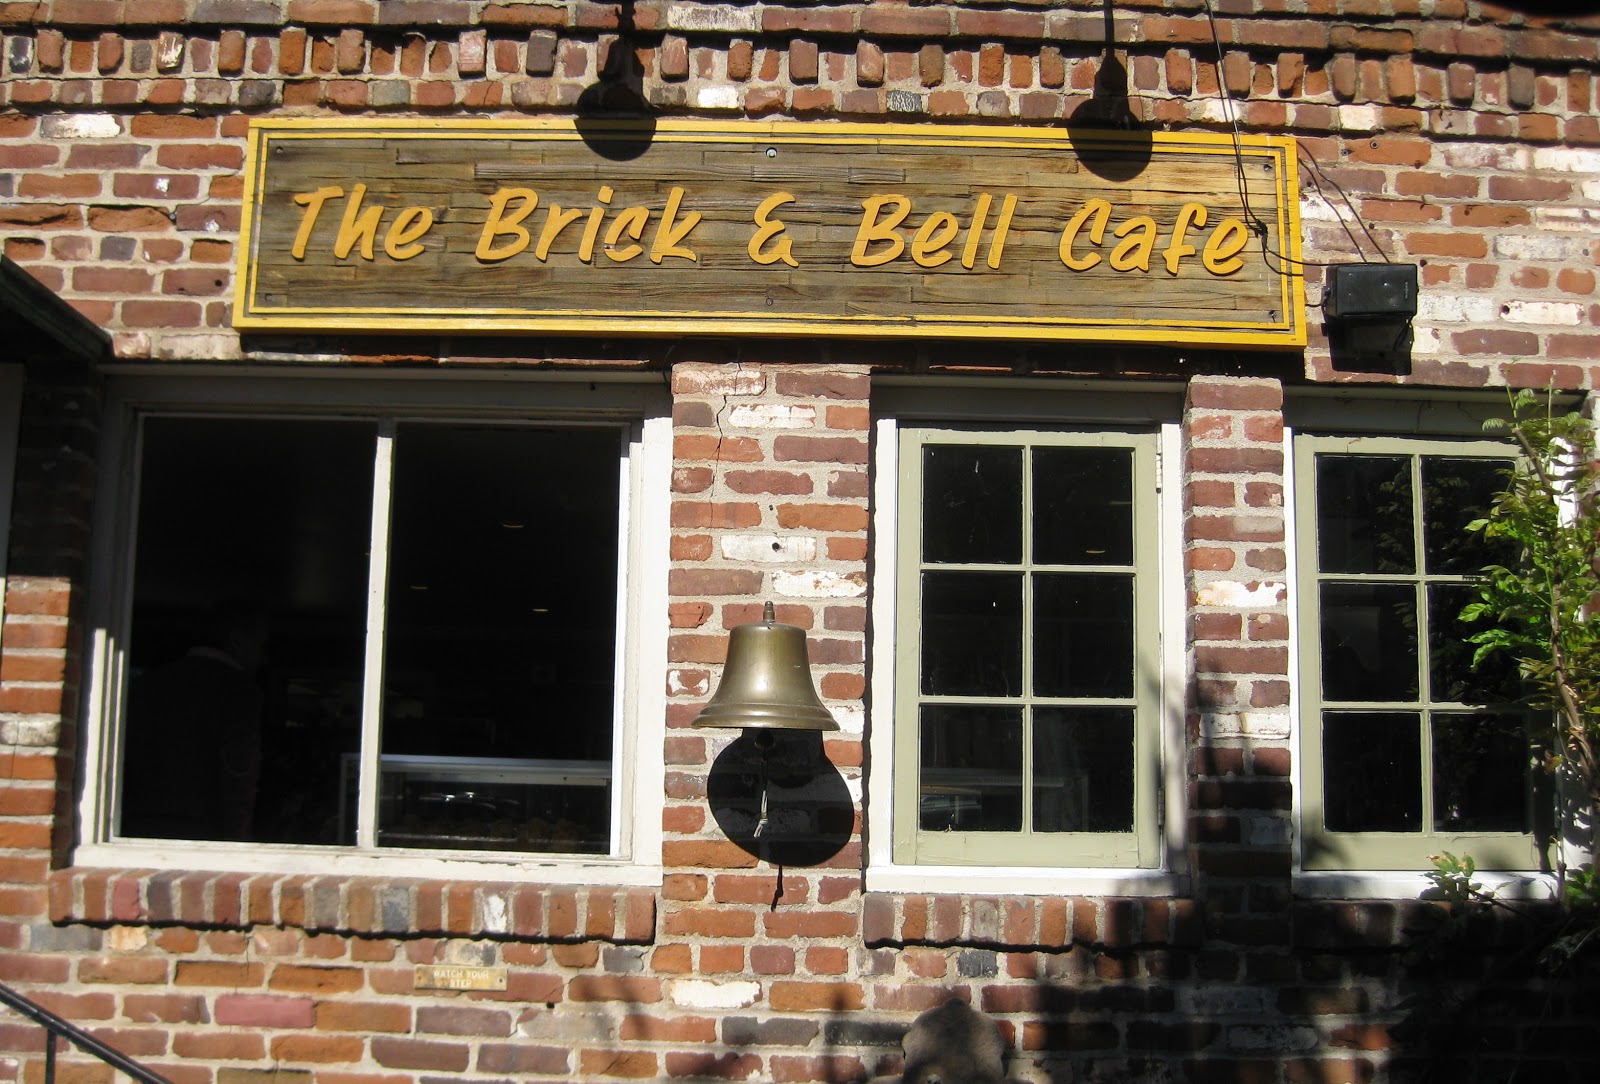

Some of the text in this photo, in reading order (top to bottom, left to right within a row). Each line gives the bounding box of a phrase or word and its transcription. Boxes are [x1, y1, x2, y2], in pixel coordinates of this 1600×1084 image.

[291, 183, 1250, 275] The Brick & Bell Cafe
[433, 970, 489, 979] WATCH YOUR
[450, 980, 472, 988] STEP
